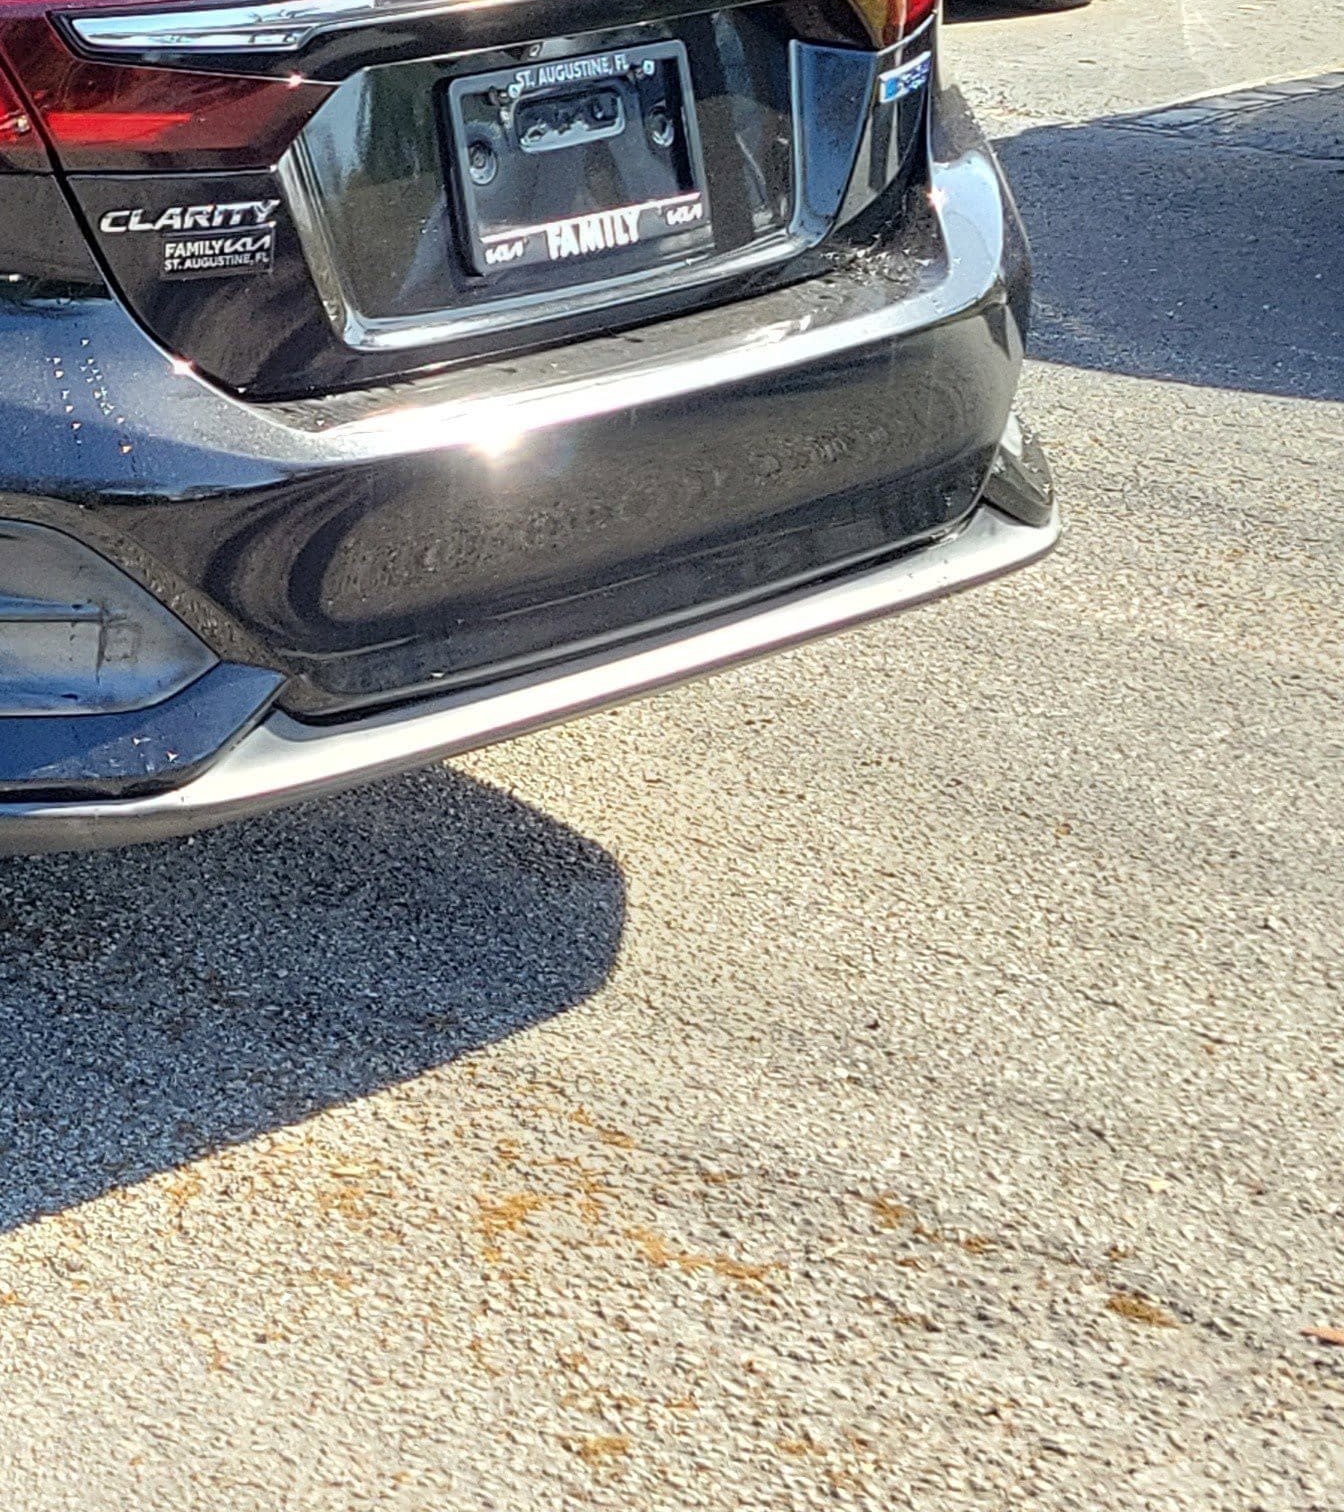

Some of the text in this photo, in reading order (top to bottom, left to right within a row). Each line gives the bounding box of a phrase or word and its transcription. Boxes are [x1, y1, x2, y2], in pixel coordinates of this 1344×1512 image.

[515, 54, 630, 88] ST. AUGUSTINE, FL
[99, 199, 281, 233] CLARITY
[485, 202, 703, 264] KIA FAMILY KIA
[164, 235, 271, 258] FAMILY KIA
[164, 251, 270, 272] ST. AUGUSTINE, FL
